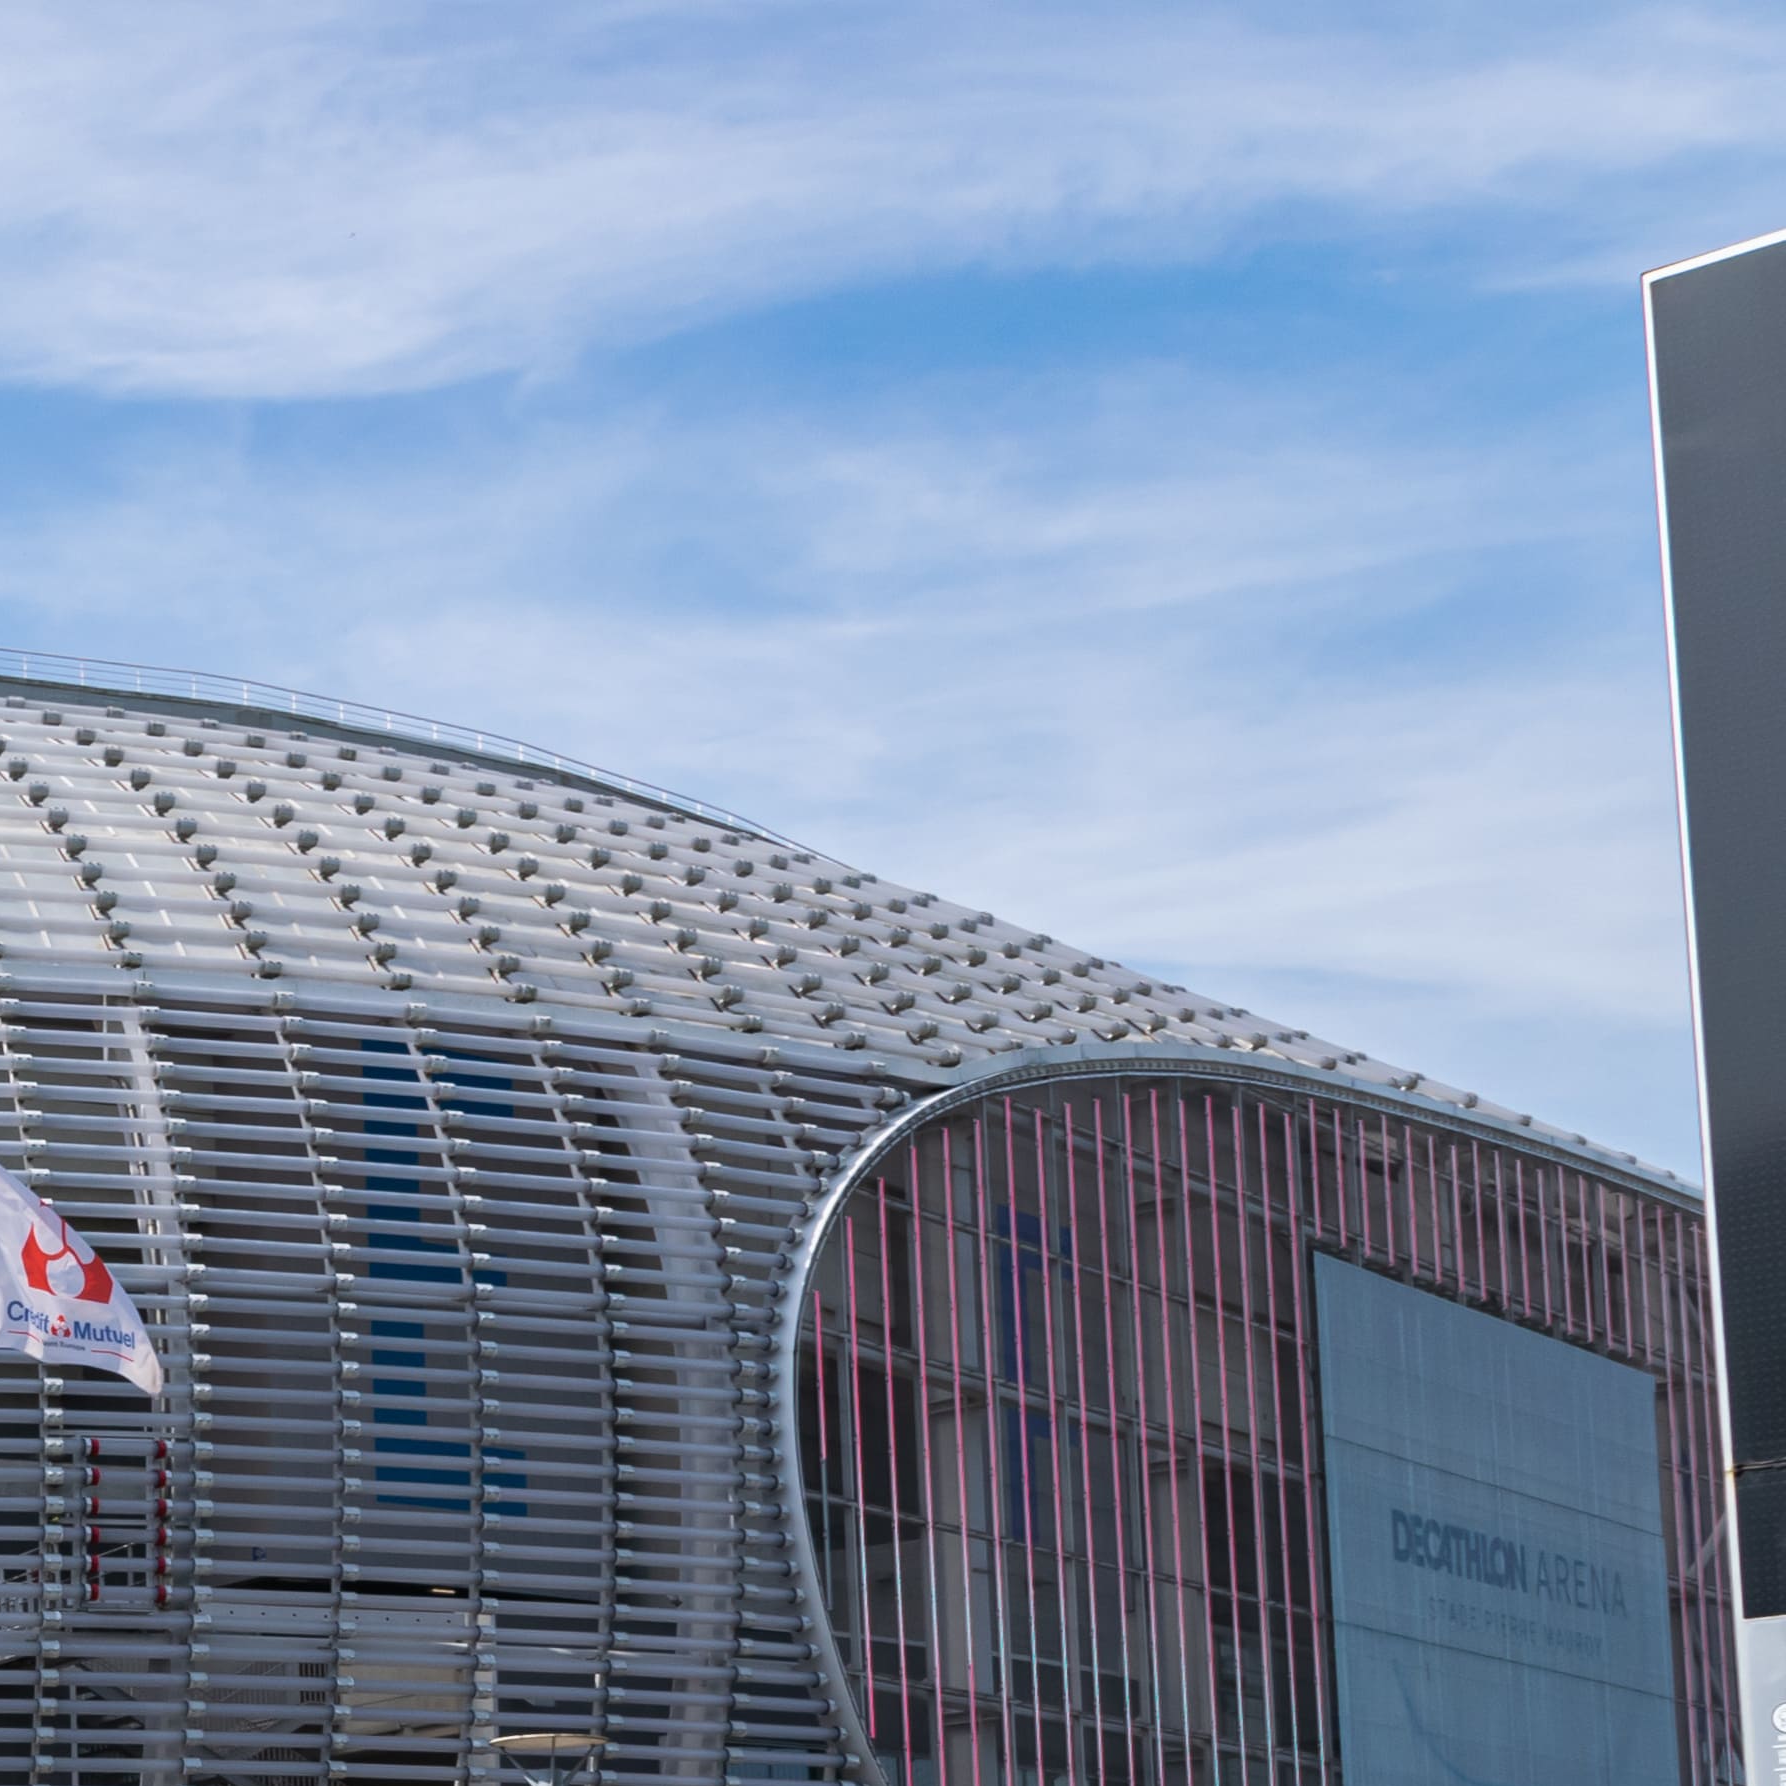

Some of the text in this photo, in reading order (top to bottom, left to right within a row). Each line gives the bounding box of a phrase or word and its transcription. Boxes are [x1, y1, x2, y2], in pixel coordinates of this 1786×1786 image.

[73, 1321, 136, 1349] Mutuel
[1391, 1508, 1627, 1619] DECATHLON ARENA
